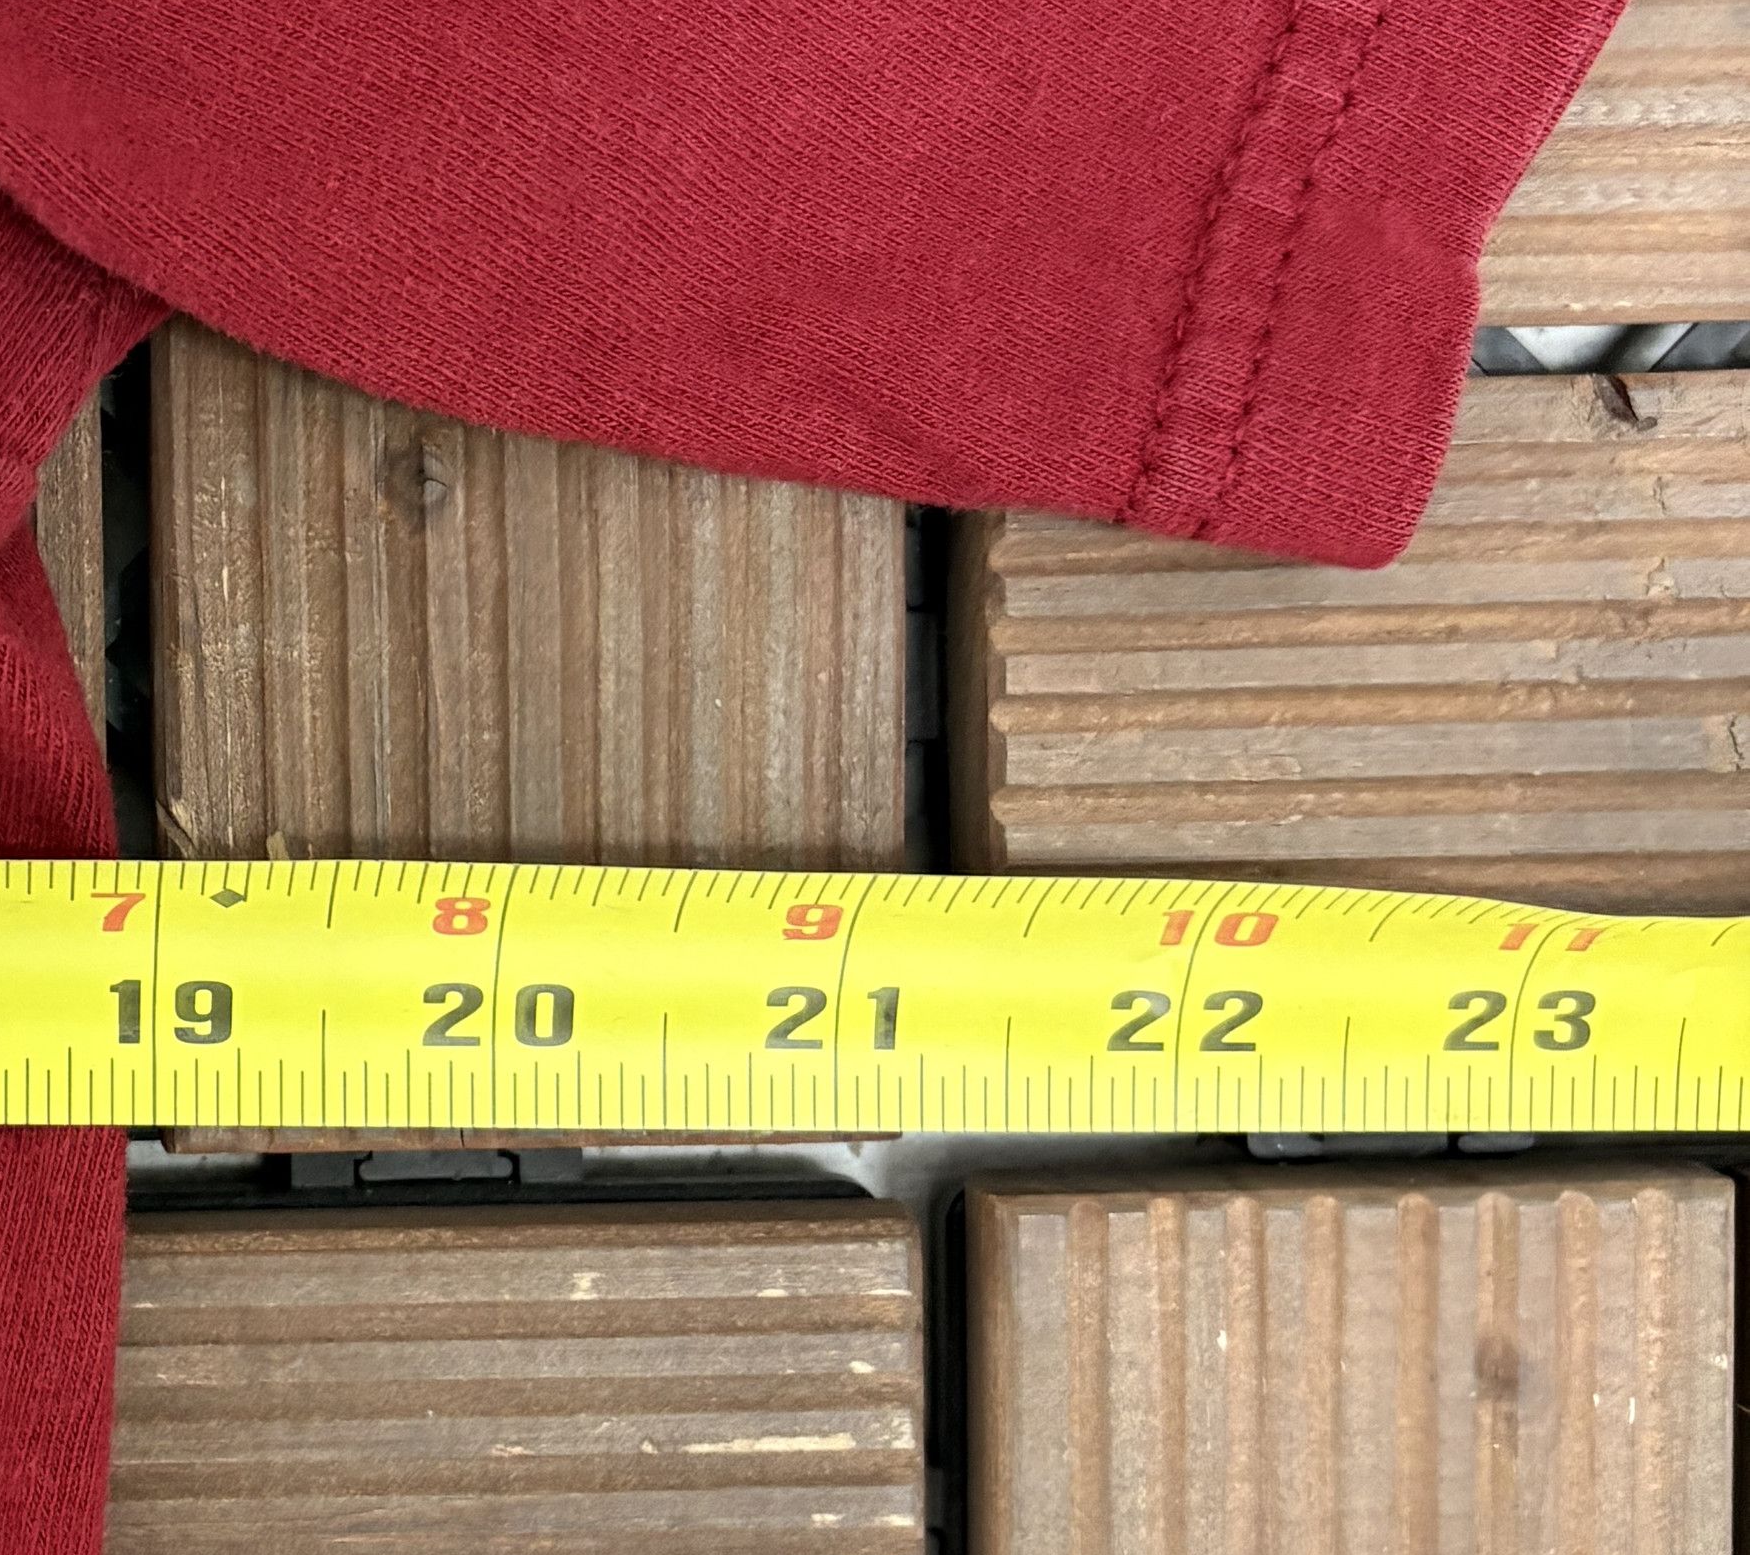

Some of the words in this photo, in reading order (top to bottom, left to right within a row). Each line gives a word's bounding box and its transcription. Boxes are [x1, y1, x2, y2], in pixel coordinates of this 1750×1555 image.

[90, 892, 147, 932] 7
[432, 897, 491, 935] 8
[782, 904, 844, 940] 9
[1159, 910, 1279, 947] 10
[1499, 923, 1603, 952] 11
[110, 979, 233, 1045] 19
[422, 983, 575, 1047] 20
[765, 986, 900, 1050] 21
[1107, 990, 1264, 1052] 22
[1443, 990, 1597, 1052] 23
